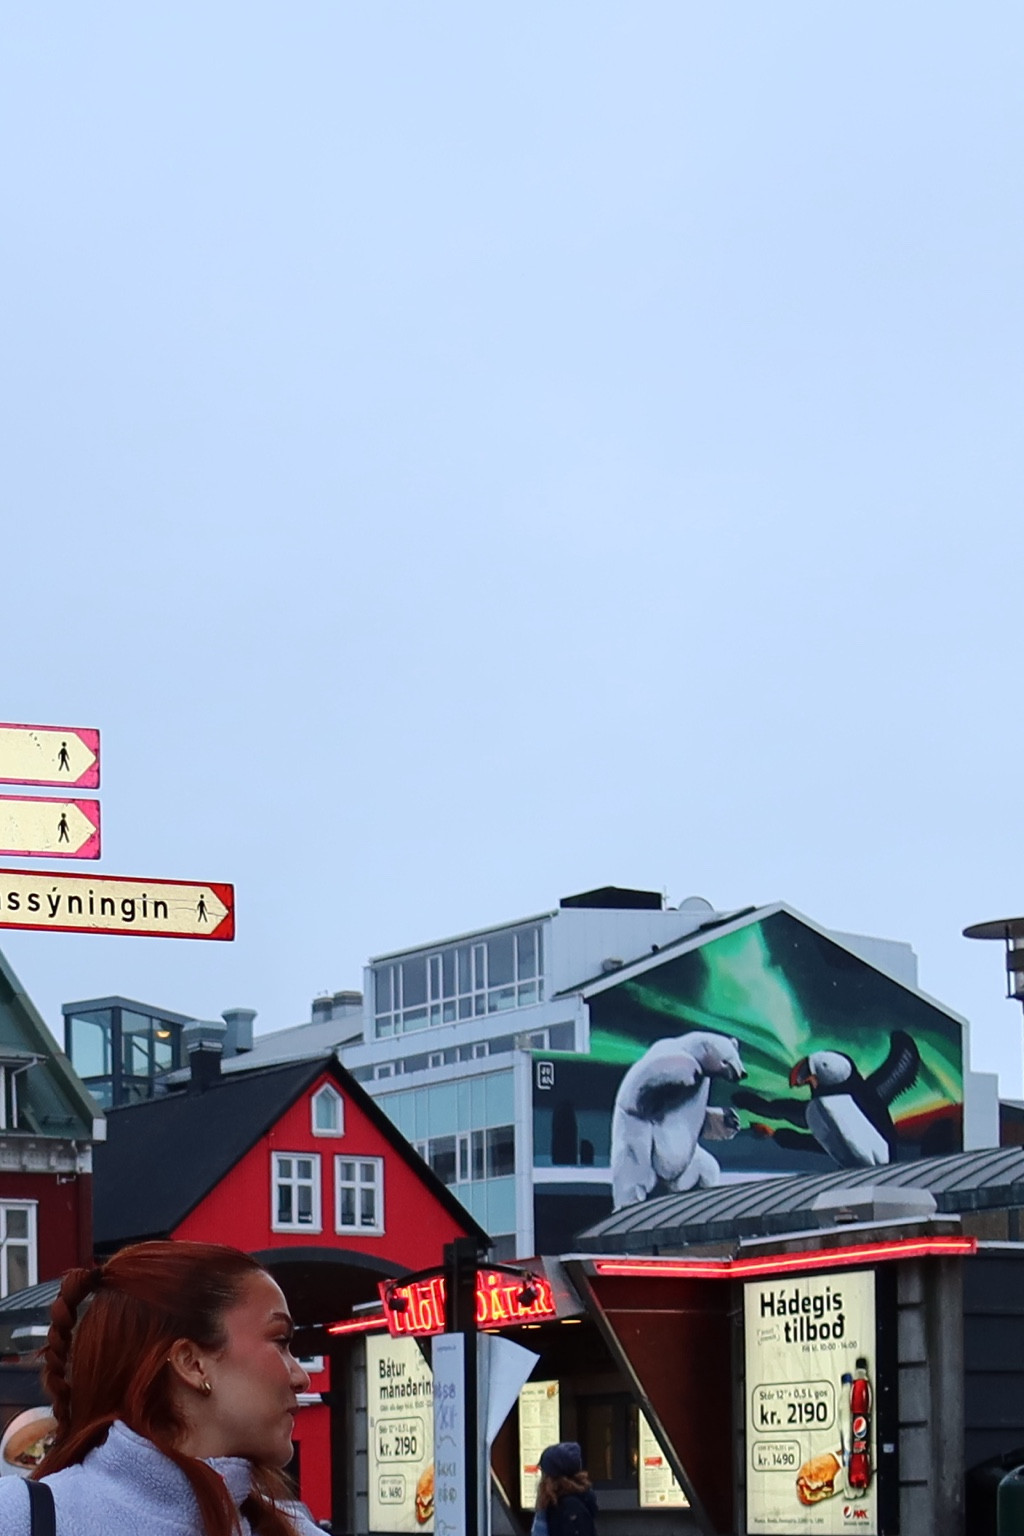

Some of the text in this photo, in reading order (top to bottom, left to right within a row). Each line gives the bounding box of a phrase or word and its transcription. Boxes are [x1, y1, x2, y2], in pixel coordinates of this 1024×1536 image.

[759, 1287, 843, 1319] Hádegis
[784, 1313, 846, 1344] tilboð
[379, 1357, 406, 1379] Bátur
[760, 1402, 827, 1426] kr. 2190
[379, 1436, 417, 1457] kr. 2190
[758, 1453, 795, 1466] kr. 1490
